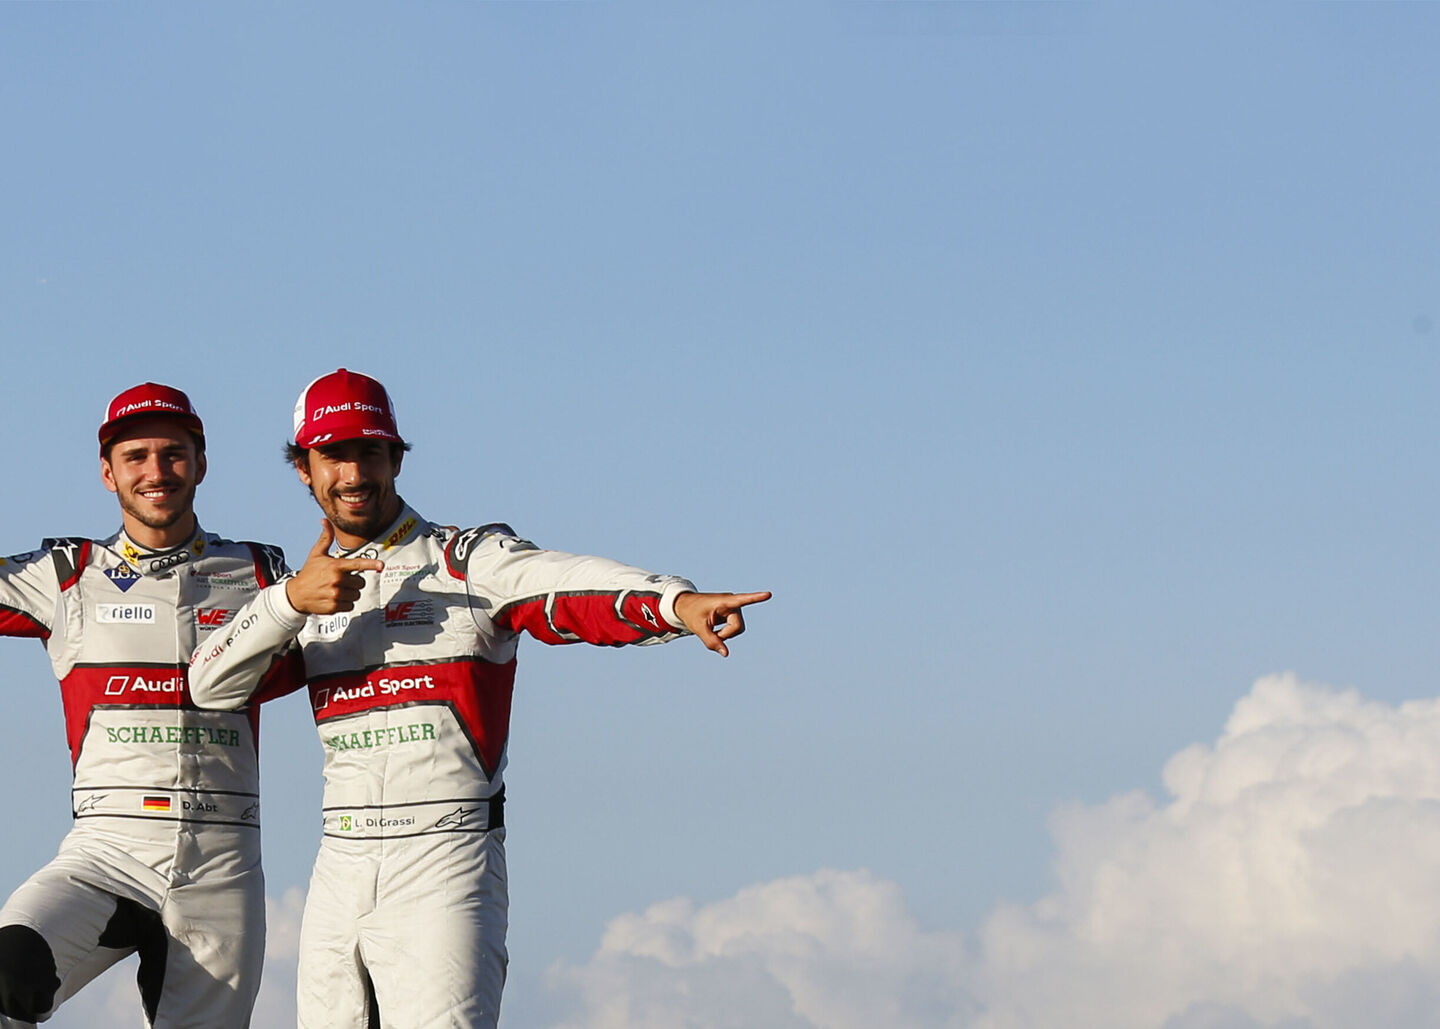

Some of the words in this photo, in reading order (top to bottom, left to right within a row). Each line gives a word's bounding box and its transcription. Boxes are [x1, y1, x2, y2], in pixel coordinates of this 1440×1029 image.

[325, 402, 351, 415] Audi
[354, 401, 383, 415] Sport
[113, 607, 152, 619] riello
[197, 608, 229, 625] WE
[318, 616, 348, 634] riello
[131, 677, 184, 692] Audi
[378, 675, 435, 696] Sport
[106, 726, 240, 747] SCHAEFFLER
[183, 801, 194, 811] D.
[196, 802, 218, 812] Abt
